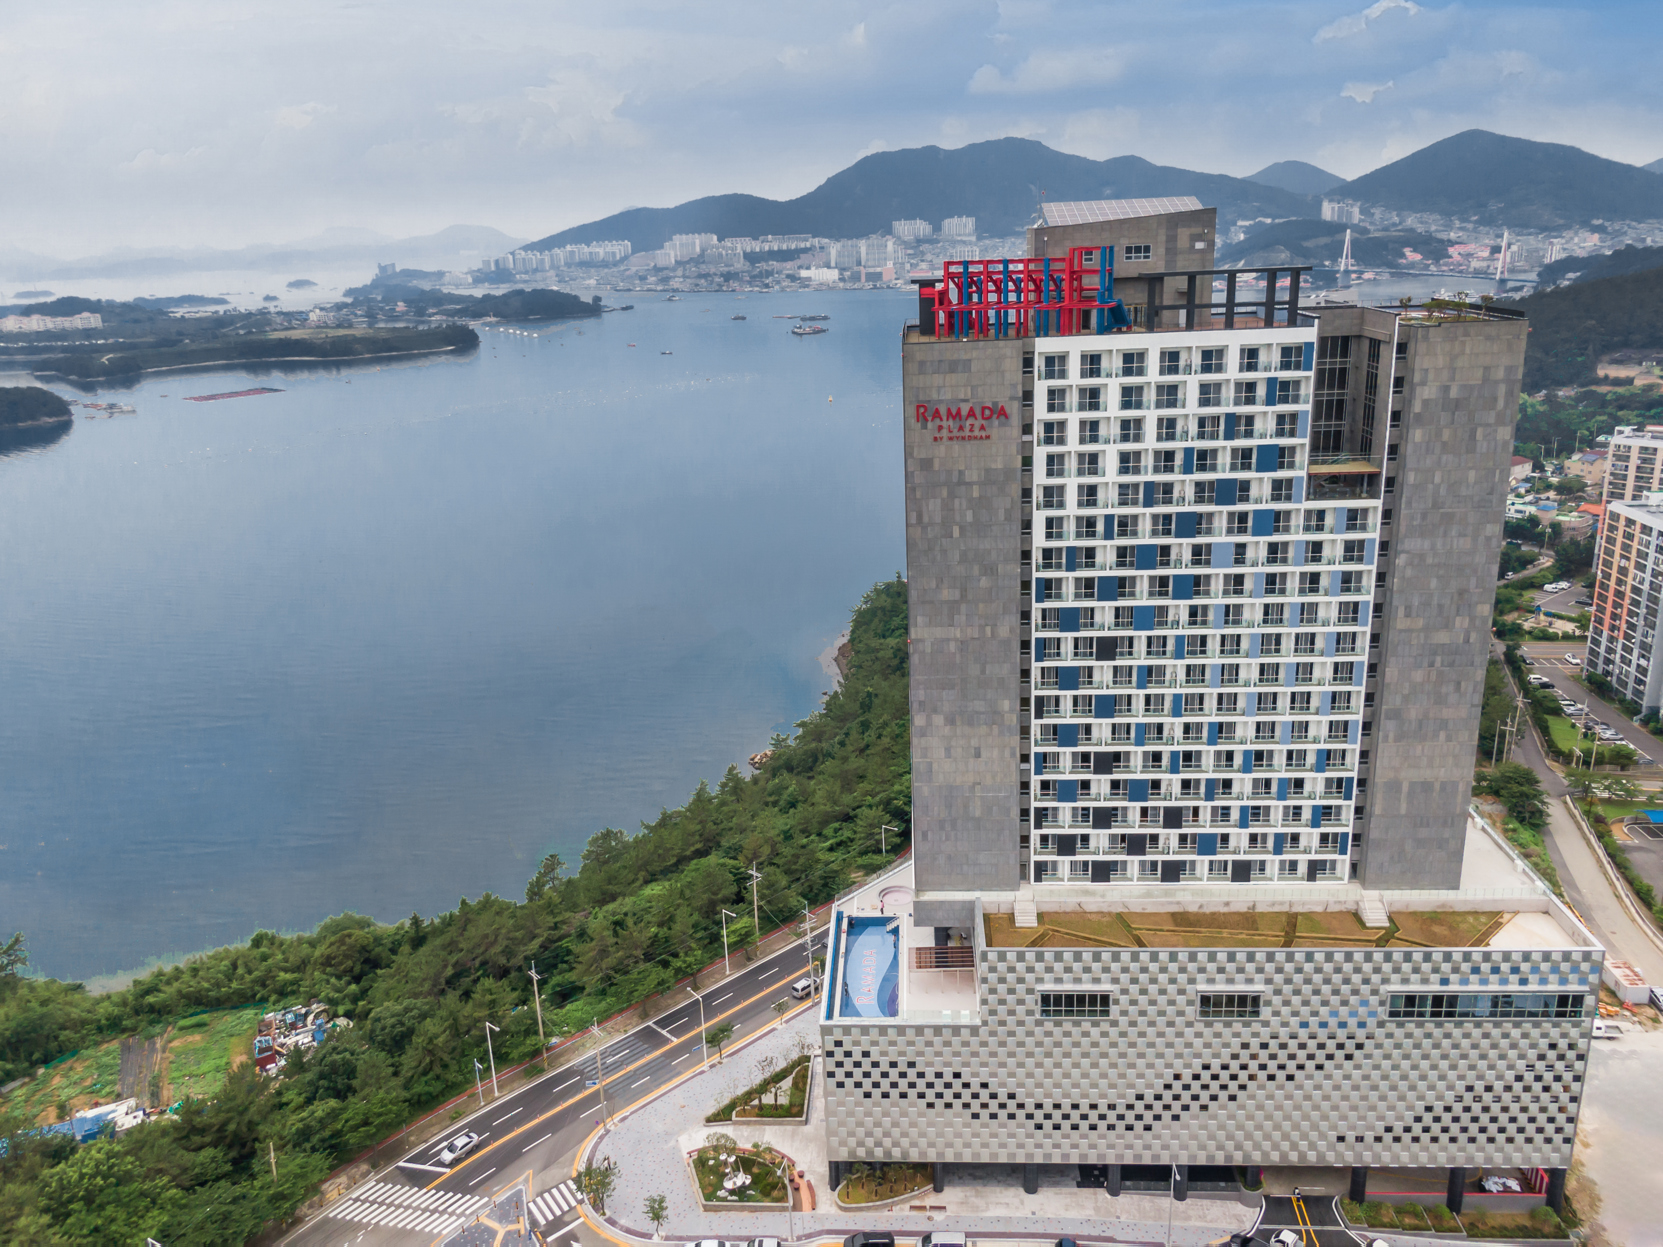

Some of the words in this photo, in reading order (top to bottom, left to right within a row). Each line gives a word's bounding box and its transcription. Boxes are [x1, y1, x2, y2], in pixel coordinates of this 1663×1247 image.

[916, 404, 1009, 422] RAMADA
[937, 423, 986, 433] PLAZA
[856, 949, 877, 1004] RAMADA
